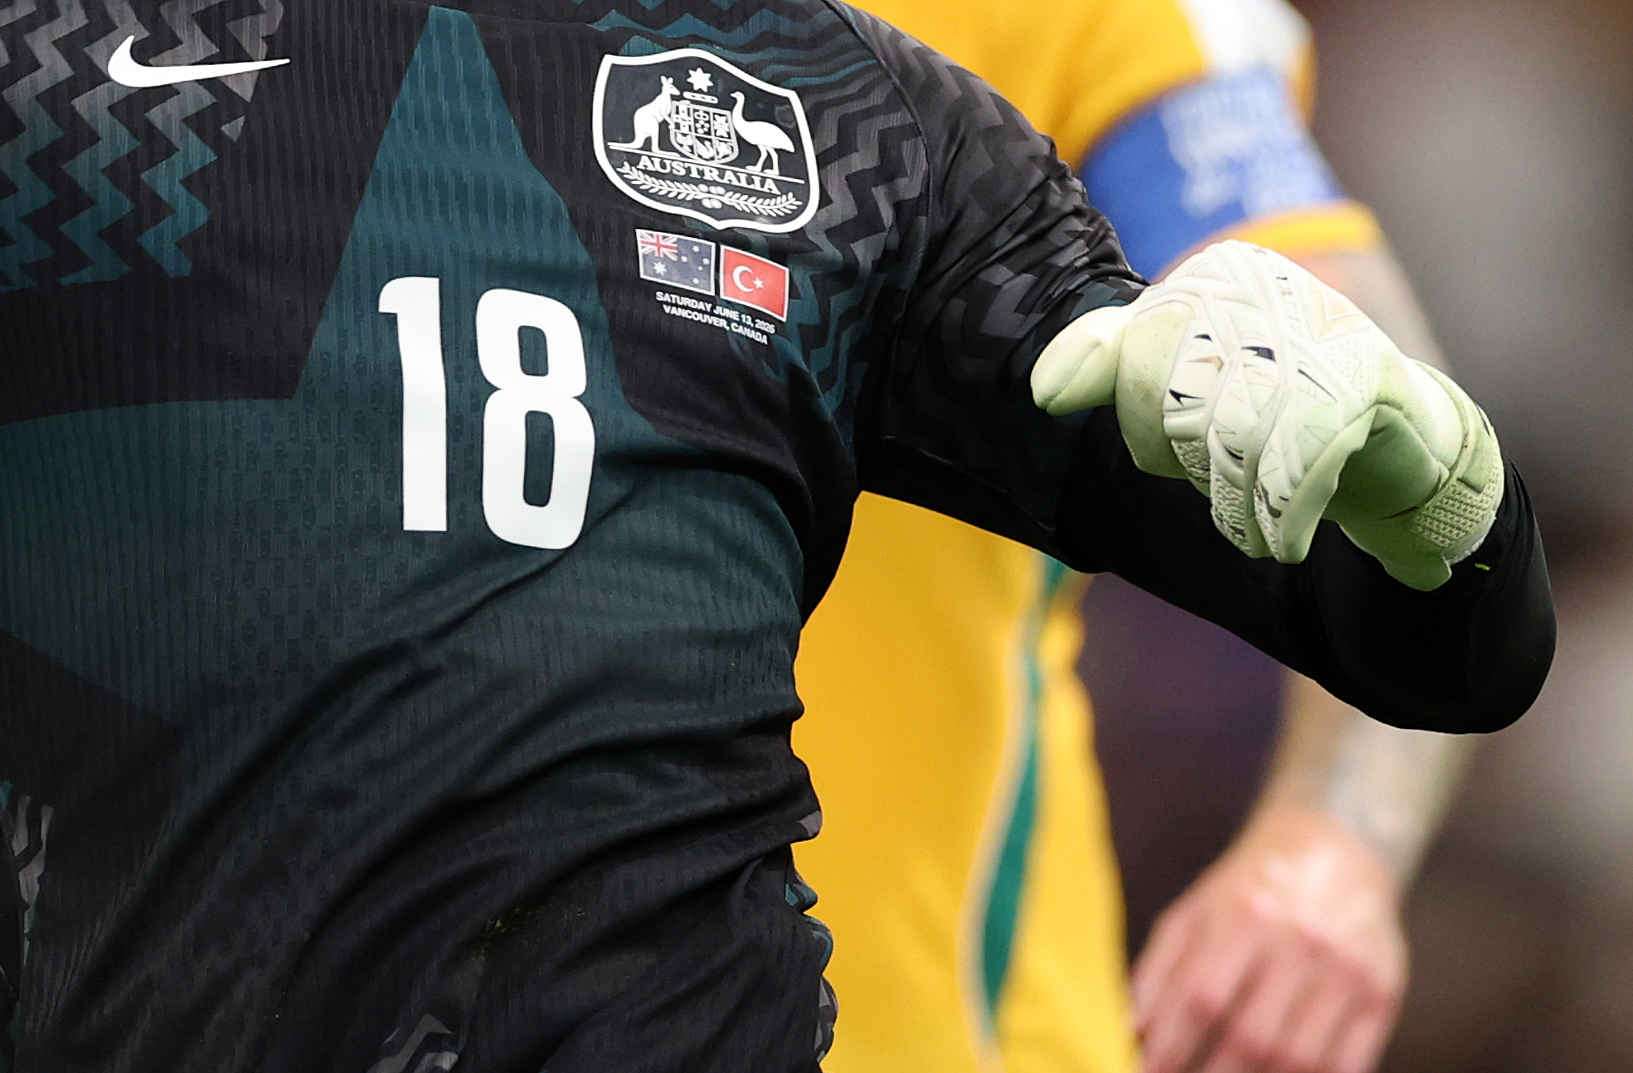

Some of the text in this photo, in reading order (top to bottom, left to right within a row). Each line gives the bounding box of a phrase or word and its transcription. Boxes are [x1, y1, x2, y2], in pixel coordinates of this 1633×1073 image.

[636, 155, 781, 195] AUSTRALIA
[655, 291, 712, 313] SATURDAY
[713, 305, 739, 322] JUNE
[740, 313, 754, 327] 13,
[662, 304, 768, 345] VANCOUVER, CANADA
[378, 276, 596, 550] 18
